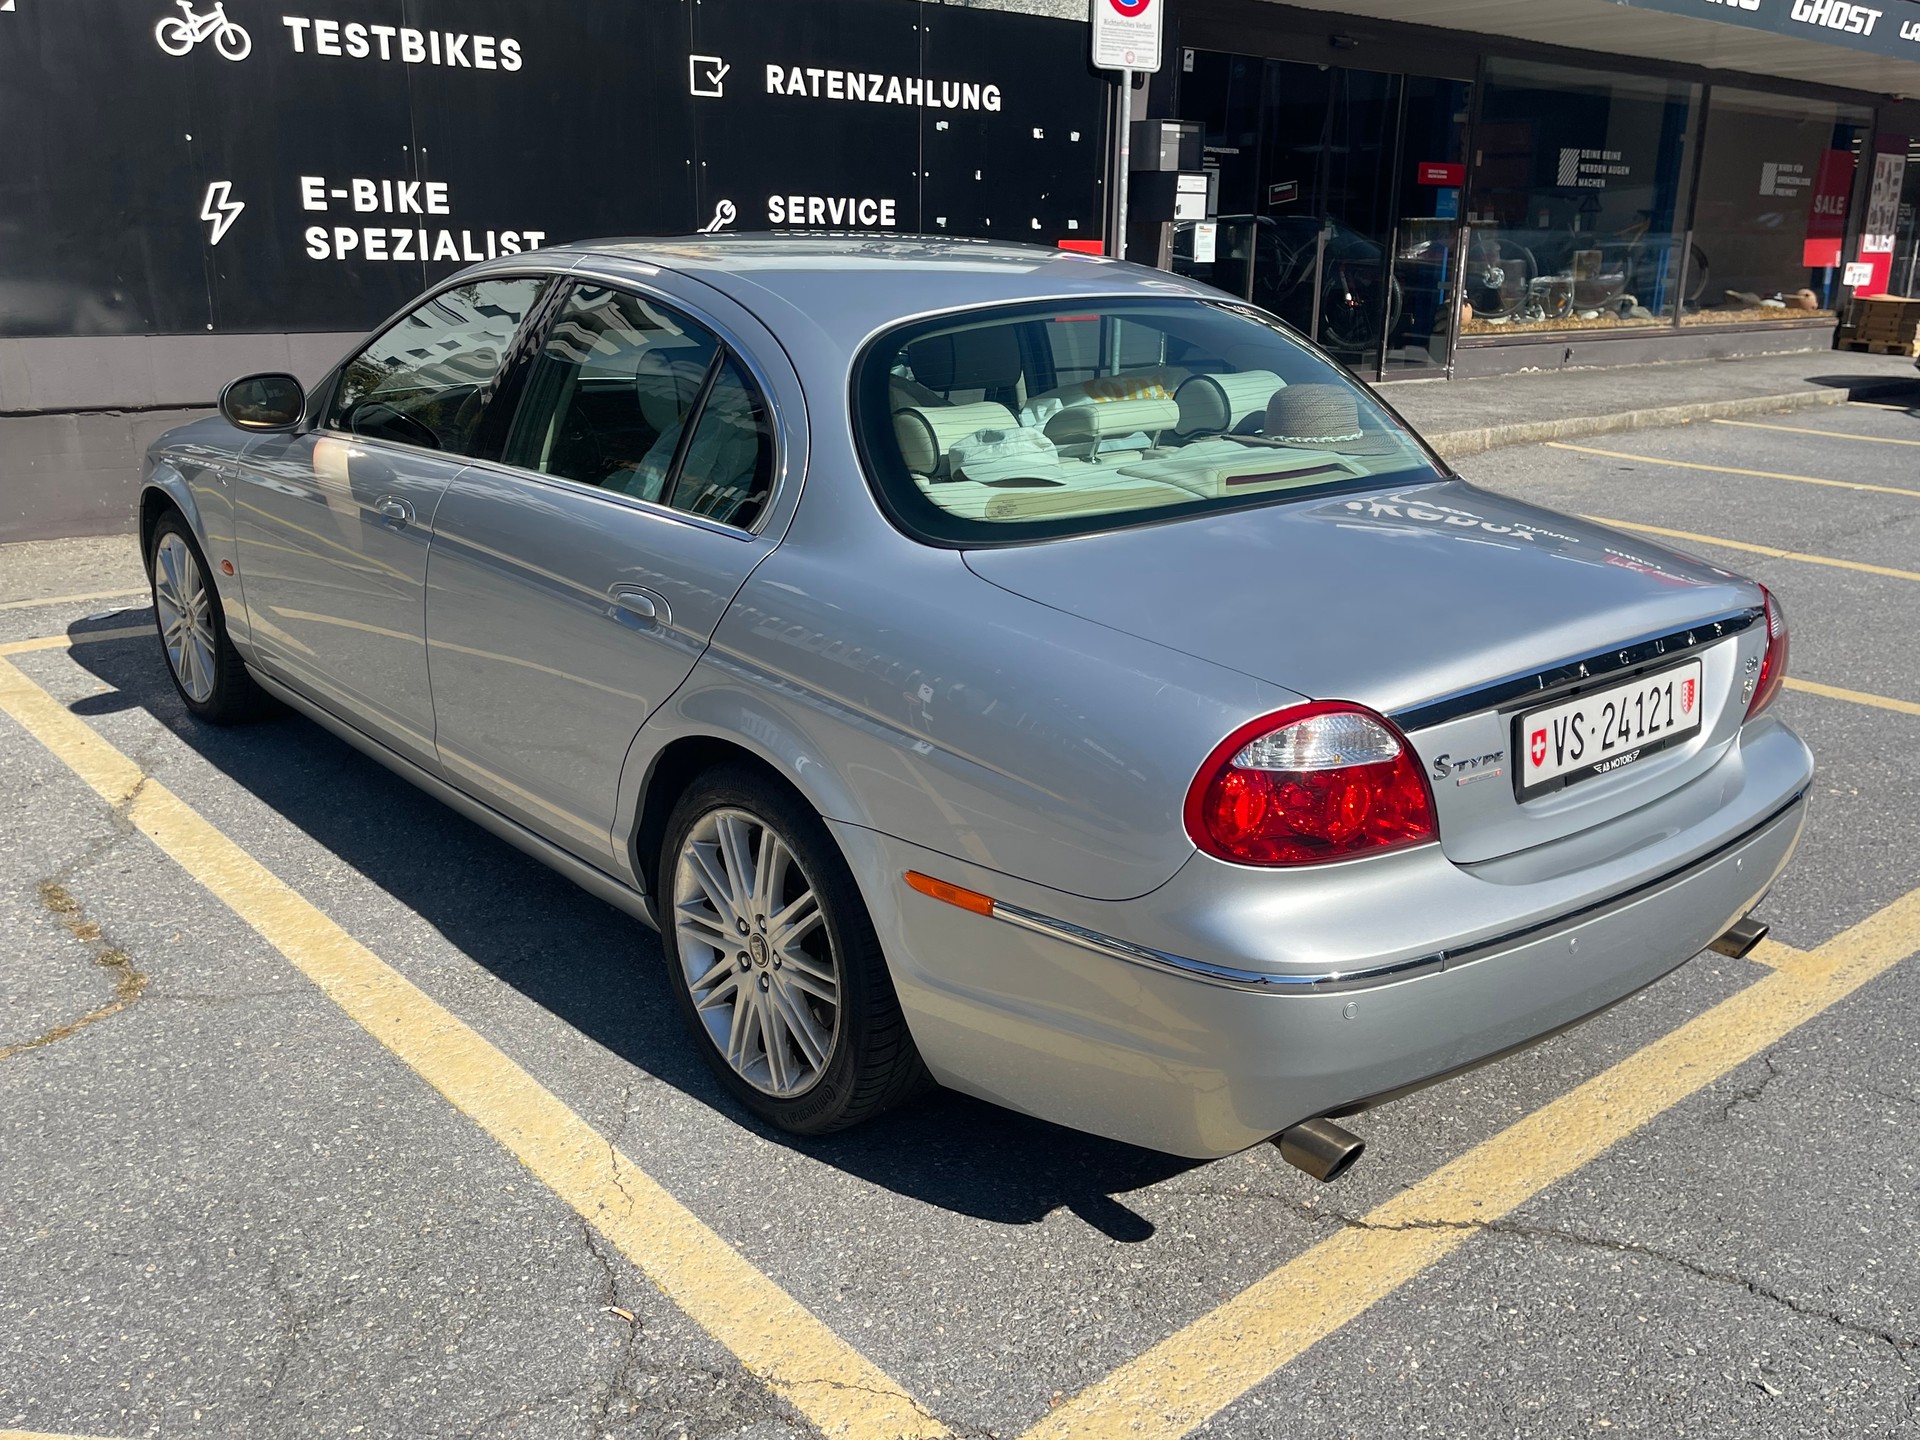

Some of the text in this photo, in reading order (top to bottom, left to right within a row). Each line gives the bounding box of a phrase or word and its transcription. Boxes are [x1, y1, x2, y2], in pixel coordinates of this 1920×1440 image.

[1790, 0, 1883, 37] GHOST
[282, 15, 523, 72] TESTBIKES
[766, 64, 1001, 112] RATENZAHLUNG
[300, 176, 450, 215] E-BIKE
[768, 195, 896, 226] SERVICE
[1814, 194, 1845, 215] SALE
[305, 227, 546, 262] SPEZIALIST
[1611, 753, 1633, 770] MOTORS
